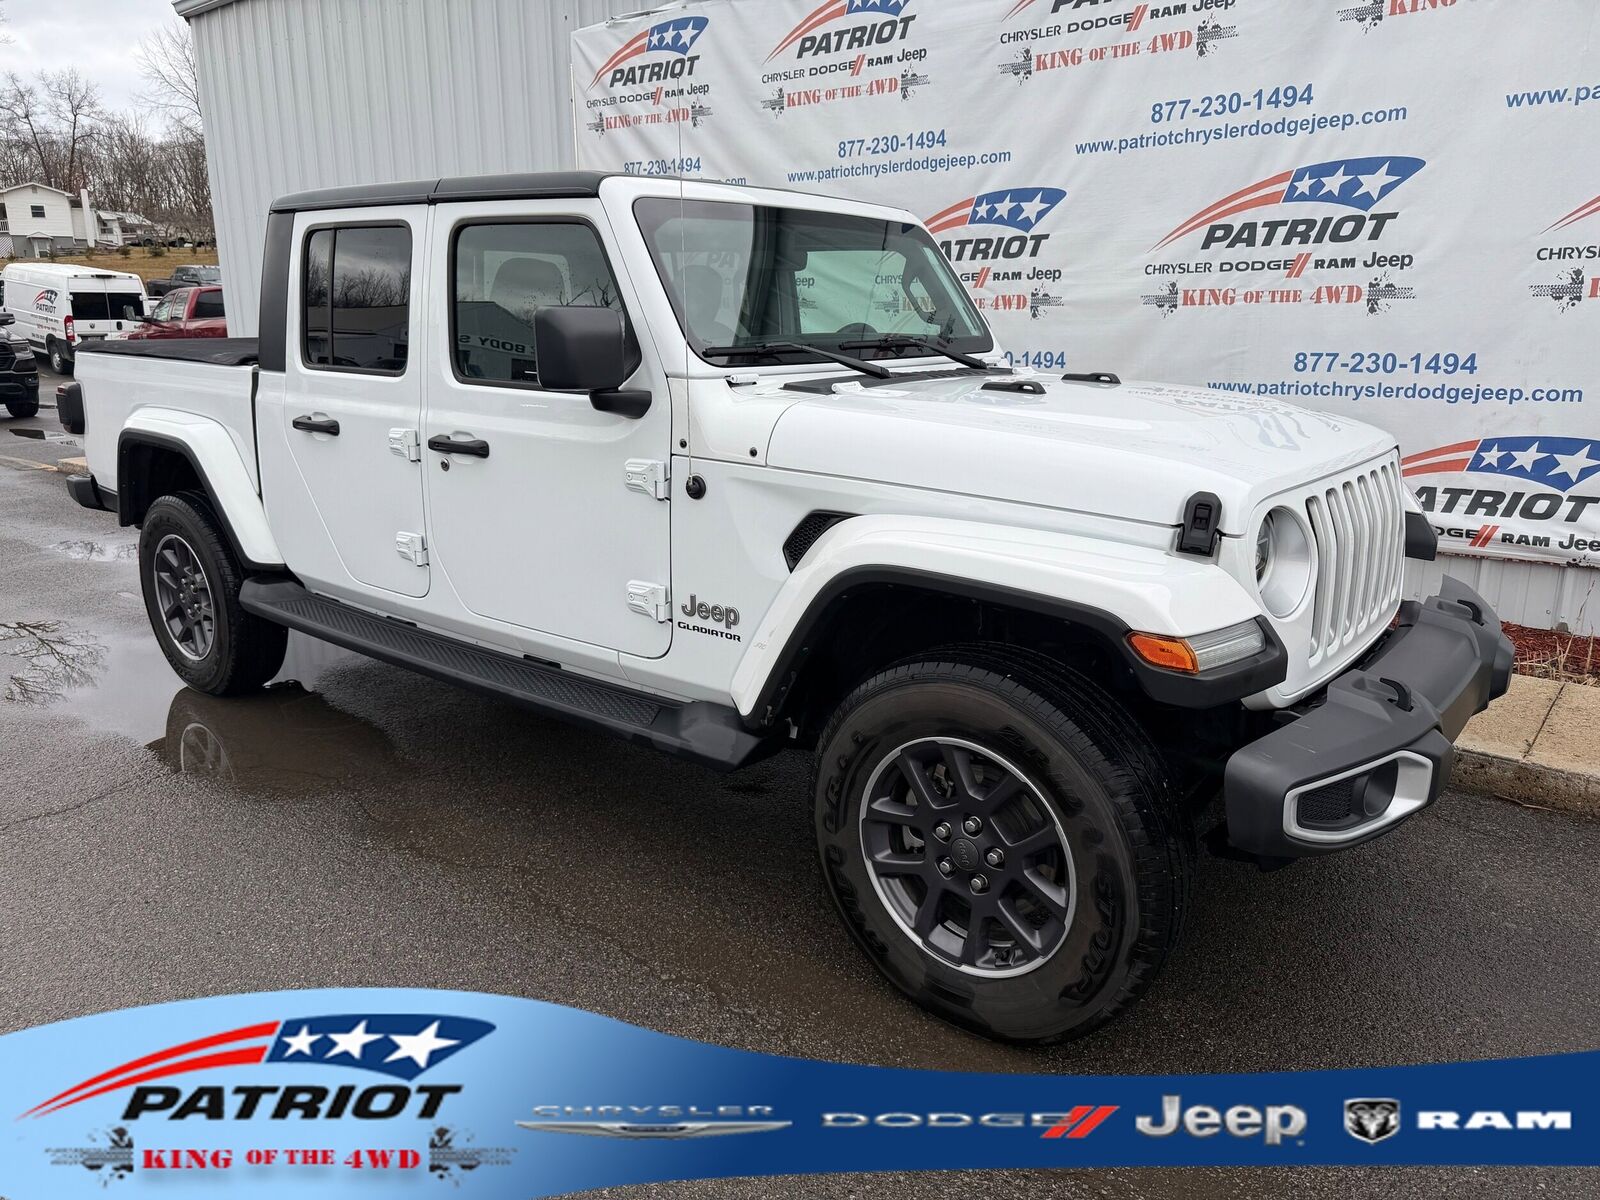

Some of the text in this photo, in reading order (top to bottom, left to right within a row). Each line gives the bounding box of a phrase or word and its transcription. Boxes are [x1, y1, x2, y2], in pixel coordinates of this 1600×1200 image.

[797, 14, 916, 59] PATRIOT
[1000, 25, 1062, 44] CHRYSLER
[1067, 12, 1134, 33] DODGE
[1150, 4, 1187, 20] RAM
[1035, 30, 1193, 72] KING OF THE 4WD
[610, 55, 700, 88] PATRIOT
[762, 48, 927, 83] CHRYSLER DODGE RAM Jeep
[587, 83, 709, 108] CHRYSLER DODGE RAM Jeep
[786, 77, 899, 107] KING OF THE 4WD
[1150, 83, 1314, 124] 877-230-1494
[605, 108, 689, 129] KING OF THE 4WD
[1075, 105, 1408, 155] www.patriotchryslerdodgejeep.com
[838, 129, 947, 158] 877-230-1494
[624, 157, 701, 175] 877-230-1494
[787, 150, 1011, 183] www.patriotchryslerdodgejeep.com
[1200, 212, 1400, 250] PATRIOT
[940, 234, 1050, 261] ATRIOT
[1537, 245, 1600, 260] CHRYS
[993, 271, 1021, 281] RAM
[1027, 267, 1061, 282] Jeep
[1145, 252, 1413, 276] CHRYSLER DODGE RAM Jeep
[796, 277, 814, 288] eep
[1182, 285, 1362, 306] KING OF THE 4WD
[36, 303, 56, 314] PATRIOT
[990, 294, 1027, 310] 4WD
[1293, 352, 1478, 375] 877-230-1494
[1207, 379, 1583, 404] www.patriotchryslerdodgejeep.com
[1415, 486, 1600, 522] ATRIOT
[1501, 533, 1550, 547] RAM
[1558, 534, 1600, 552] Jee
[681, 593, 740, 630] Jeep
[678, 621, 741, 642] GLADIATOR
